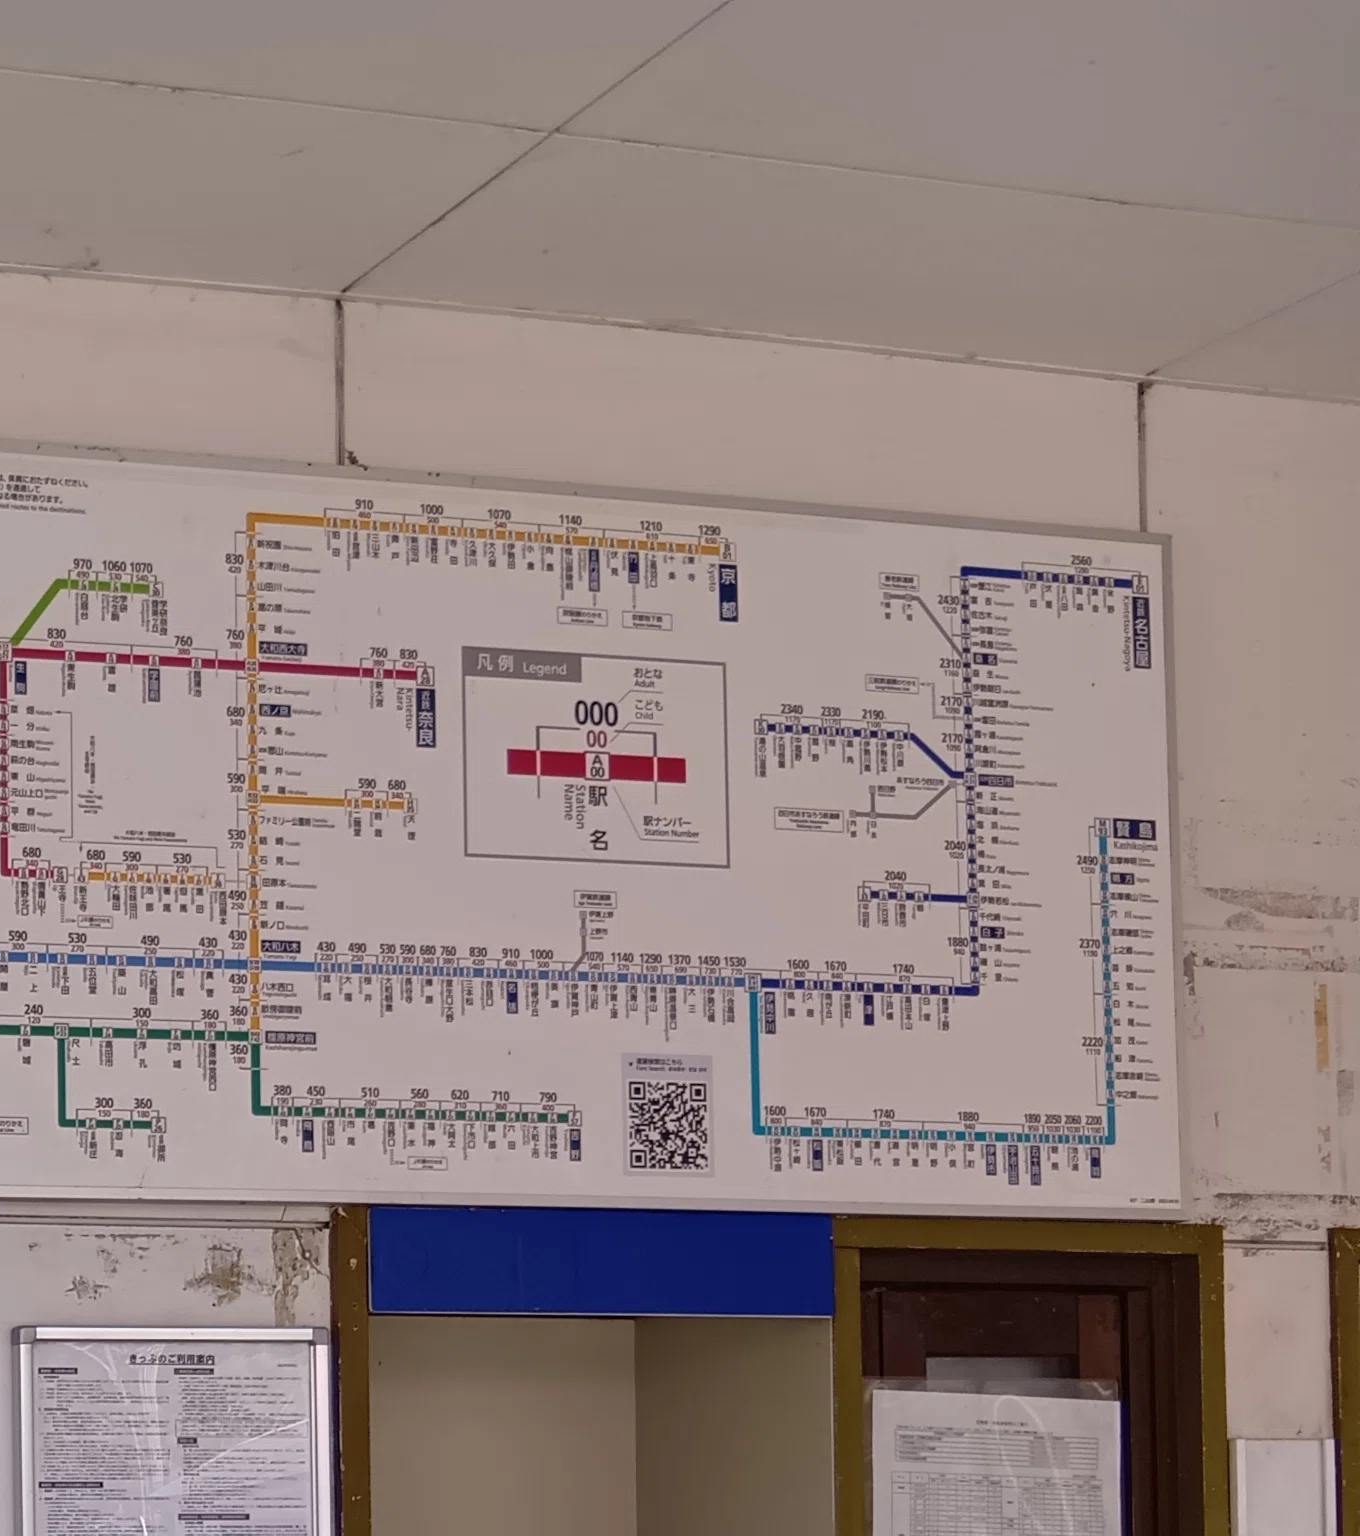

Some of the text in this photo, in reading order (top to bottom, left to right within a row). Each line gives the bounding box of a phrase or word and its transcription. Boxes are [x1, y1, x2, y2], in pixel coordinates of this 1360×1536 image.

[698, 525, 721, 537] 1290
[1071, 556, 1092, 566] 2560
[708, 563, 716, 592] Kyoto
[721, 567, 737, 619] 京都
[47, 628, 66, 640] 830
[477, 653, 513, 672] 凡例
[523, 662, 567, 676] Legend
[634, 667, 663, 679] おとな
[634, 679, 655, 688] Adult
[635, 699, 664, 711] こども
[419, 691, 435, 747] 近鉄奈良
[575, 700, 618, 726] 000
[635, 711, 654, 720] Child
[586, 730, 607, 748] 00
[563, 784, 575, 820] Name
[575, 784, 587, 830] Station
[588, 785, 609, 851] 駅名
[643, 815, 692, 827] 駅ナンバー
[643, 828, 700, 838] Station Number
[1116, 821, 1153, 839] 賢島
[1113, 841, 1158, 853] Kashikojima
[263, 942, 300, 952] 大和八木
[539, 1092, 557, 1102] 790
